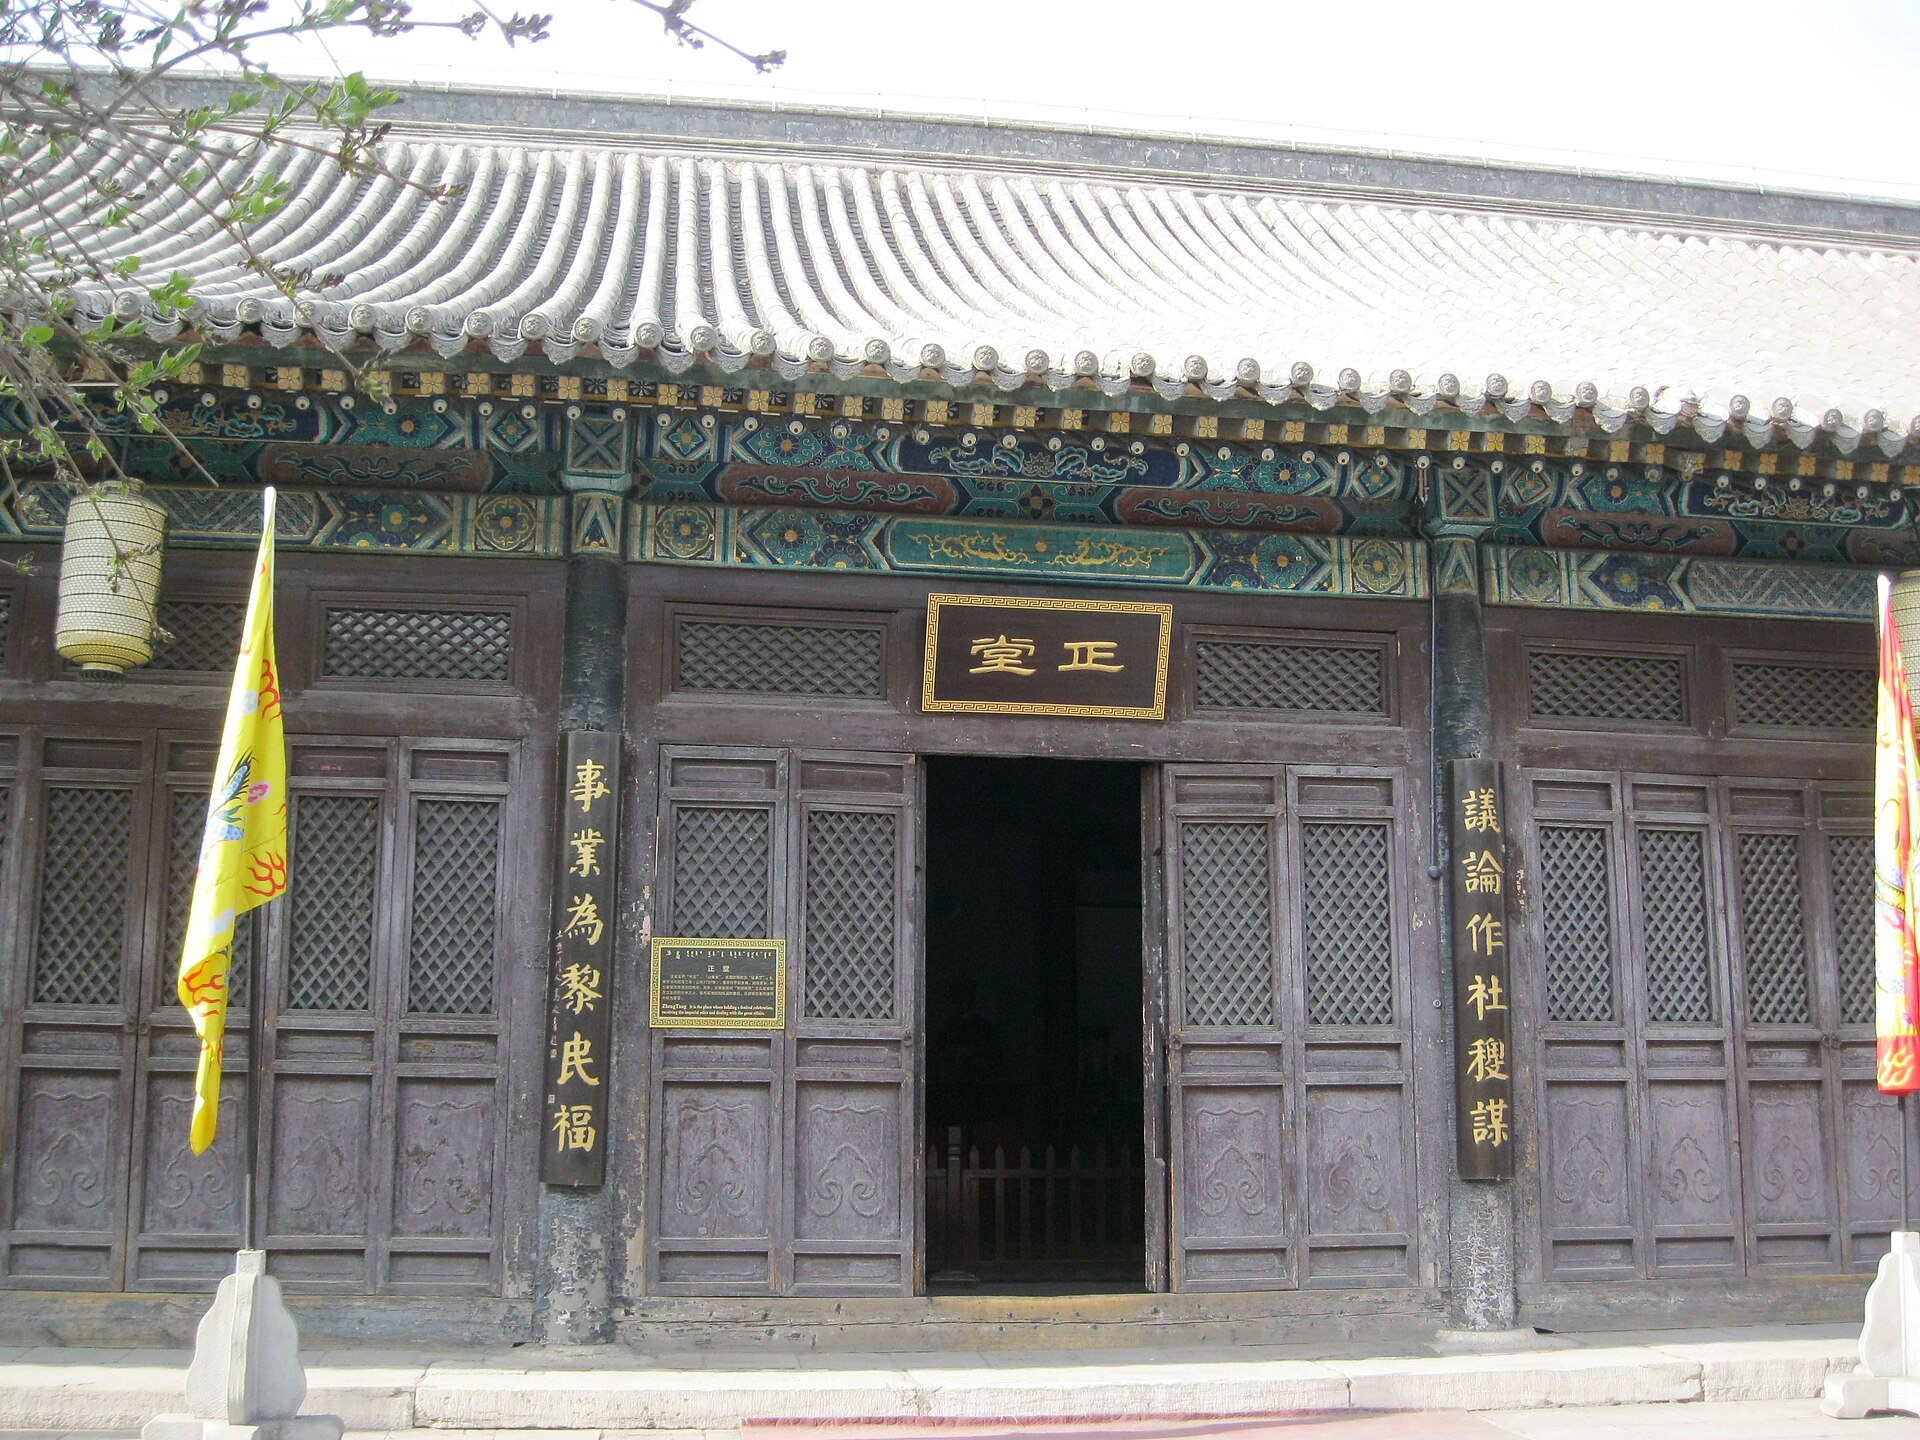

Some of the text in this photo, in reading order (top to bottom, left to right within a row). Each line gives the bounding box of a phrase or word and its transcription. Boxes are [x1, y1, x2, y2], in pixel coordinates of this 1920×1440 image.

[969, 634, 1125, 676] 正堂
[553, 759, 610, 1151] 事業為黎民福
[1462, 787, 1510, 1146] 議論作社稷謀
